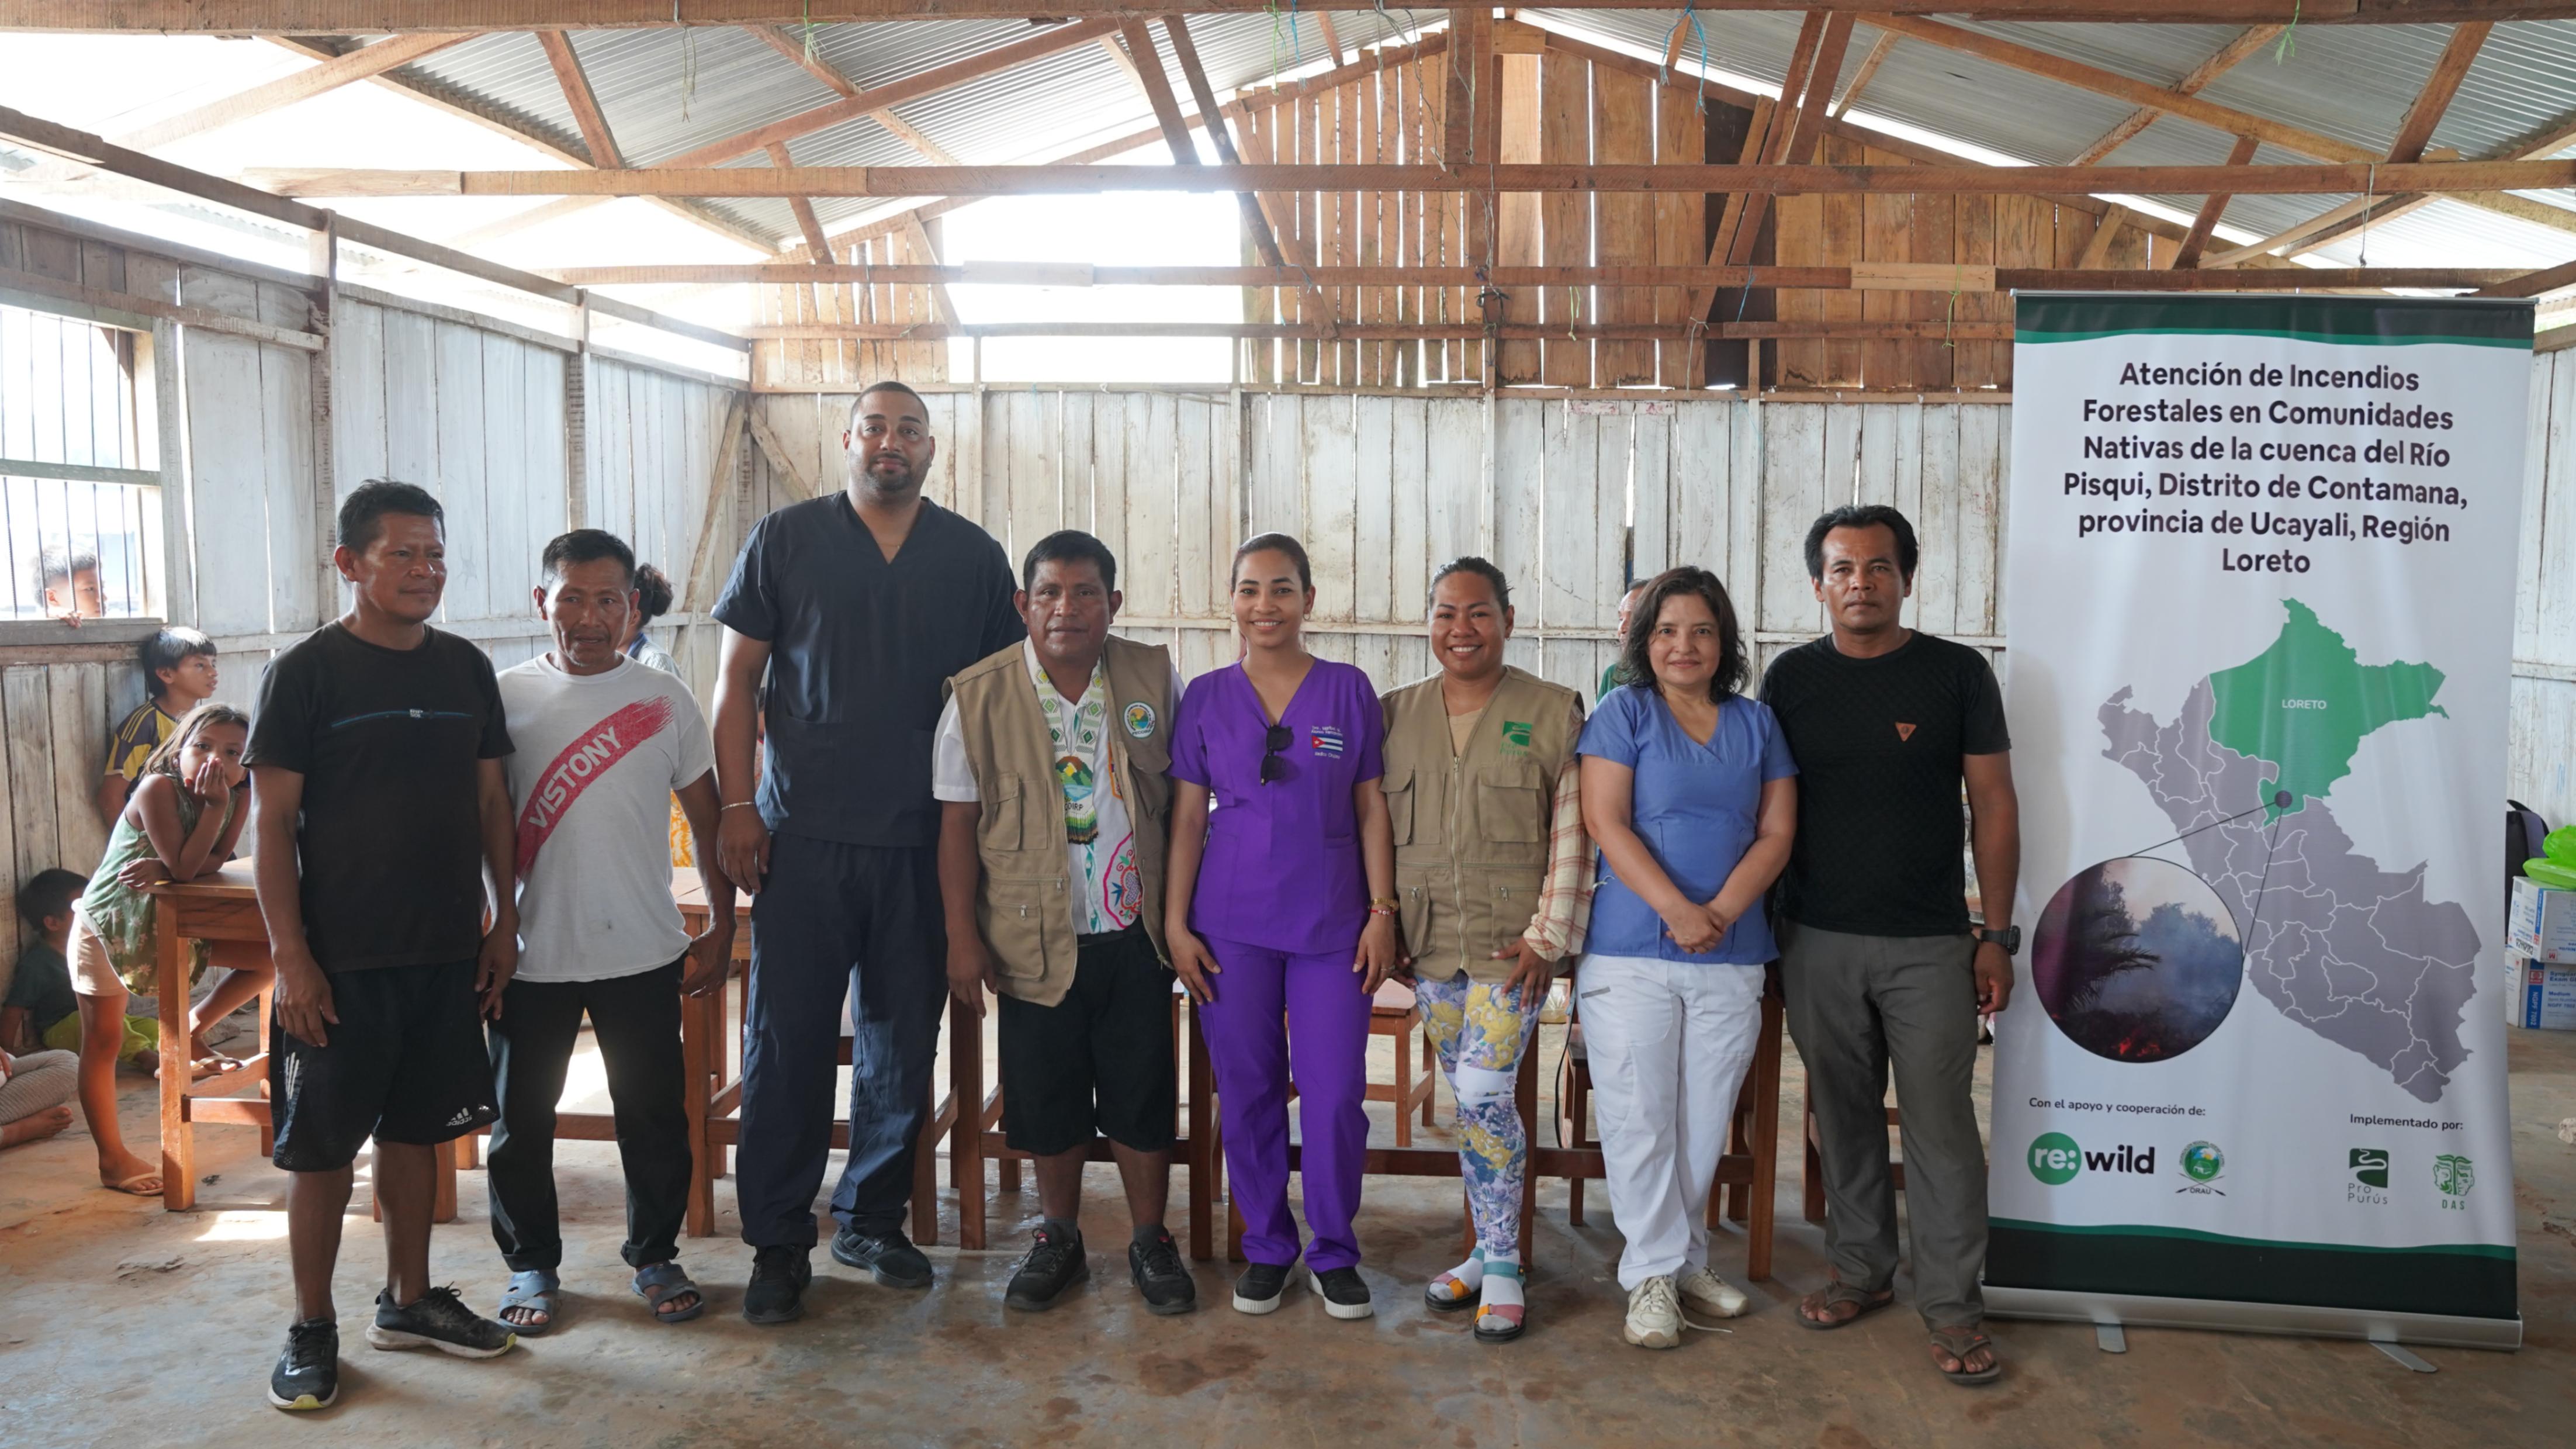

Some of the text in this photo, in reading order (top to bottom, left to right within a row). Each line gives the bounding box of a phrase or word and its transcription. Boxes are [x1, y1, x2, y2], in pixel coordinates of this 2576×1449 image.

[2120, 361, 2419, 392] Atención de Incendios
[2083, 398, 2453, 430] Forestales en Comunidades
[2084, 435, 2450, 468] Nativas de la cuenca del Río
[2064, 471, 2467, 510] Pisqui, Distrito de Contamana,
[2079, 508, 2449, 545] provincia de Ucayali, Región
[2222, 548, 2311, 573] Loreto
[2281, 698, 2327, 710] LORETO
[528, 725, 622, 829] VISTONY
[2029, 1097, 2205, 1116] Con el apoyo y cooperación de:
[2350, 1113, 2463, 1131] Implementado por:
[2348, 1183, 2371, 1194] Pro
[2348, 1193, 2388, 1205] Purús
